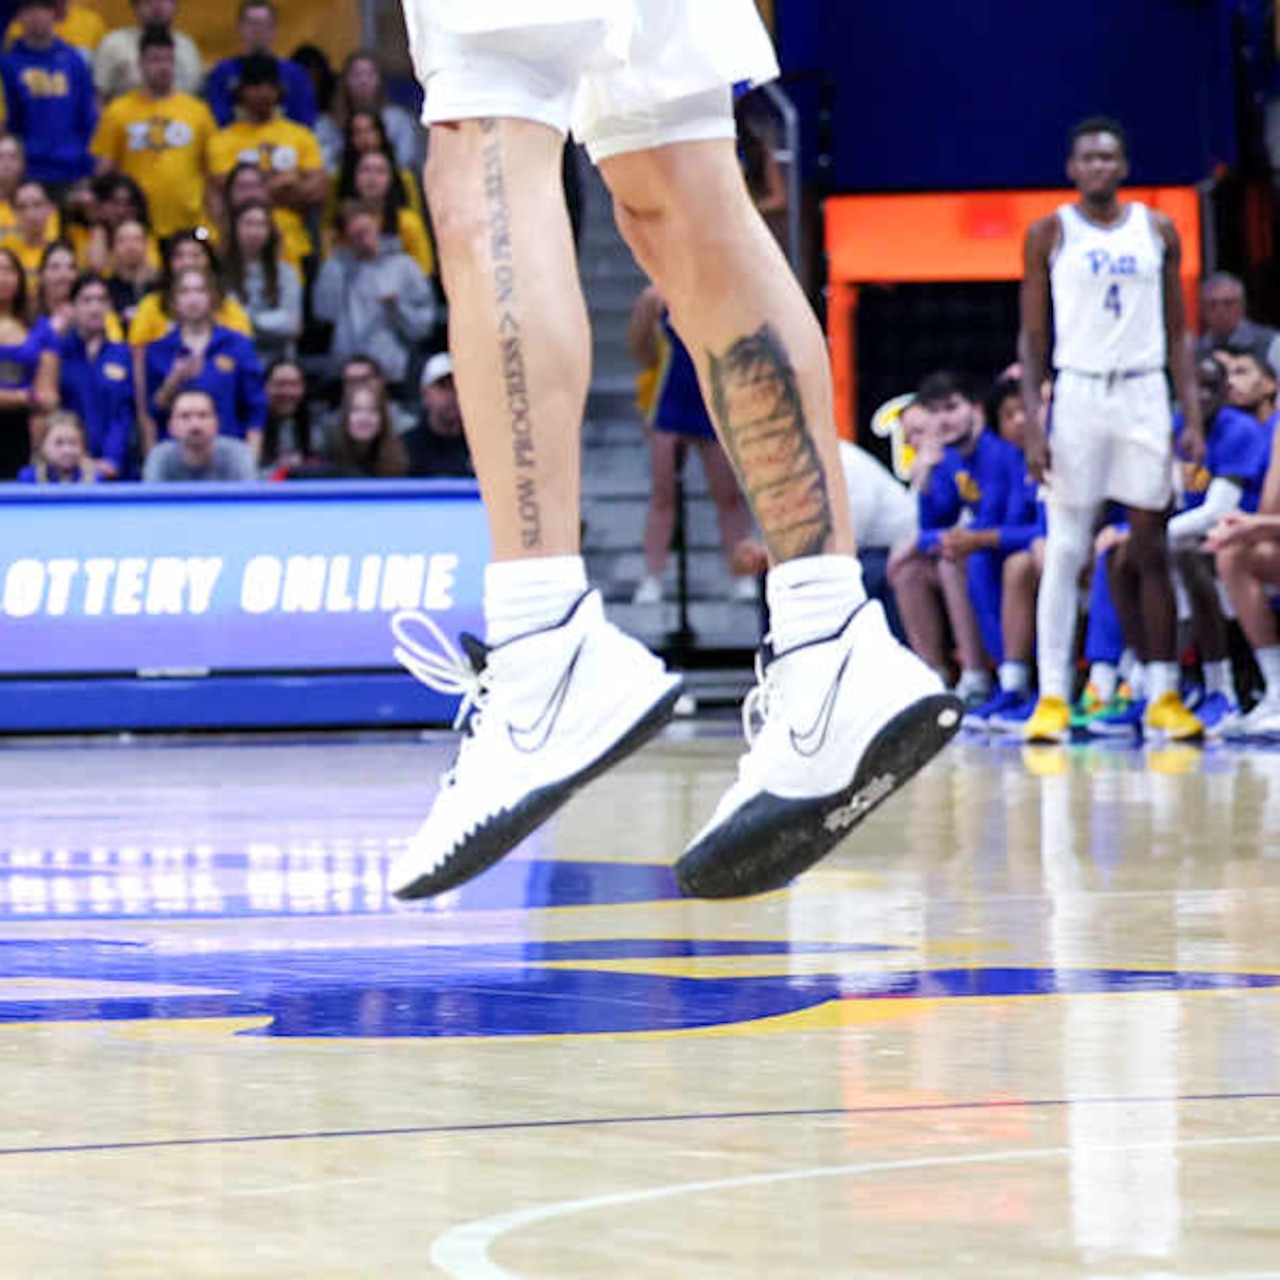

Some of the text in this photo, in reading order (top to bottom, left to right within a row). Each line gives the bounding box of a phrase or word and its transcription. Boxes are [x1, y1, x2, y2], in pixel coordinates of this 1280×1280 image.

[1103, 282, 1122, 321] 4
[517, 477, 543, 549] SLOW
[240, 552, 460, 615] ONLINE
